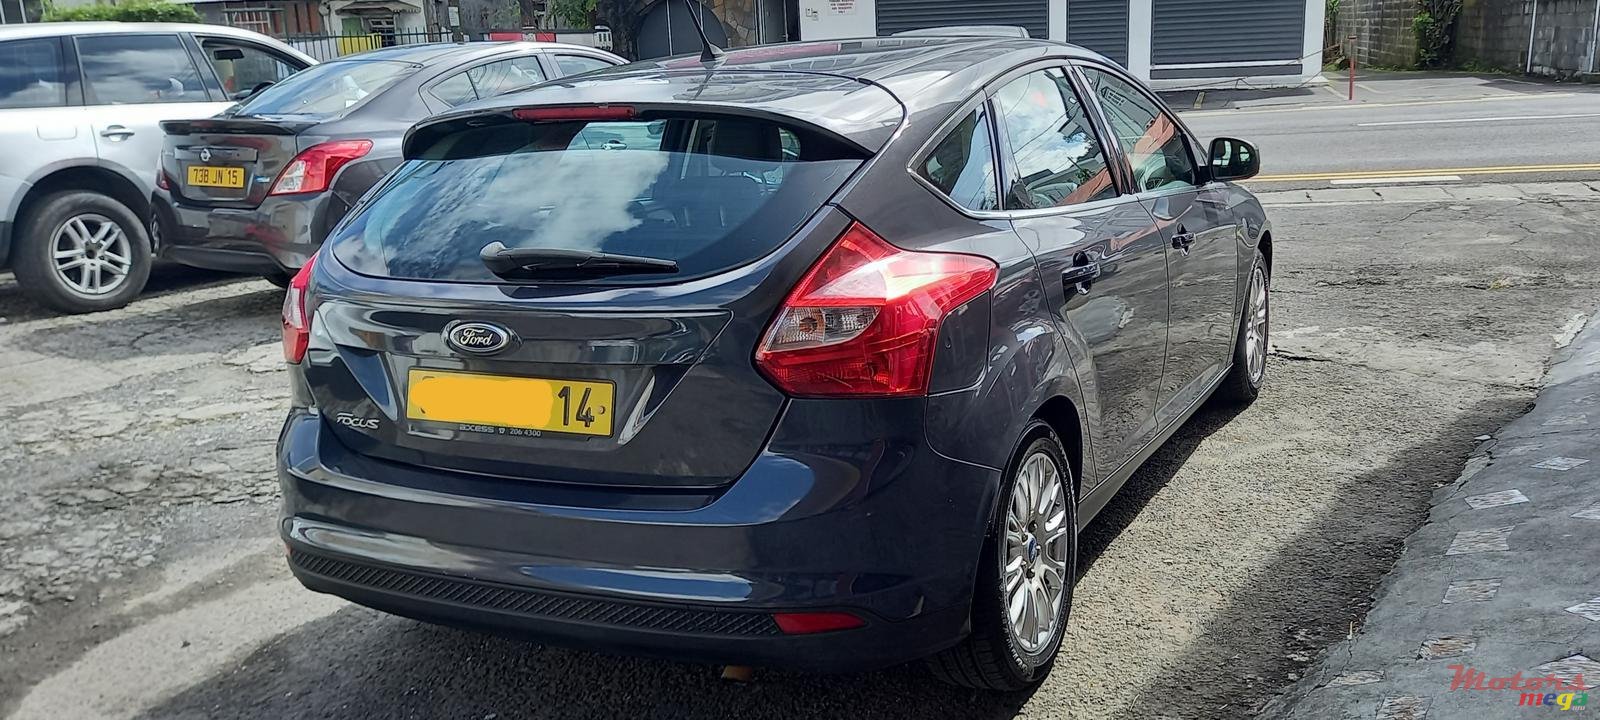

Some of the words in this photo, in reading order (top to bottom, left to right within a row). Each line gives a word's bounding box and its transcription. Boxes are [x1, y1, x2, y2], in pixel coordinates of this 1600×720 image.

[212, 169, 223, 185] JN
[227, 169, 238, 185] 15
[460, 328, 493, 347] Ford
[557, 385, 595, 428] 14
[336, 412, 380, 429] FOCUS
[524, 429, 542, 437] 4300
